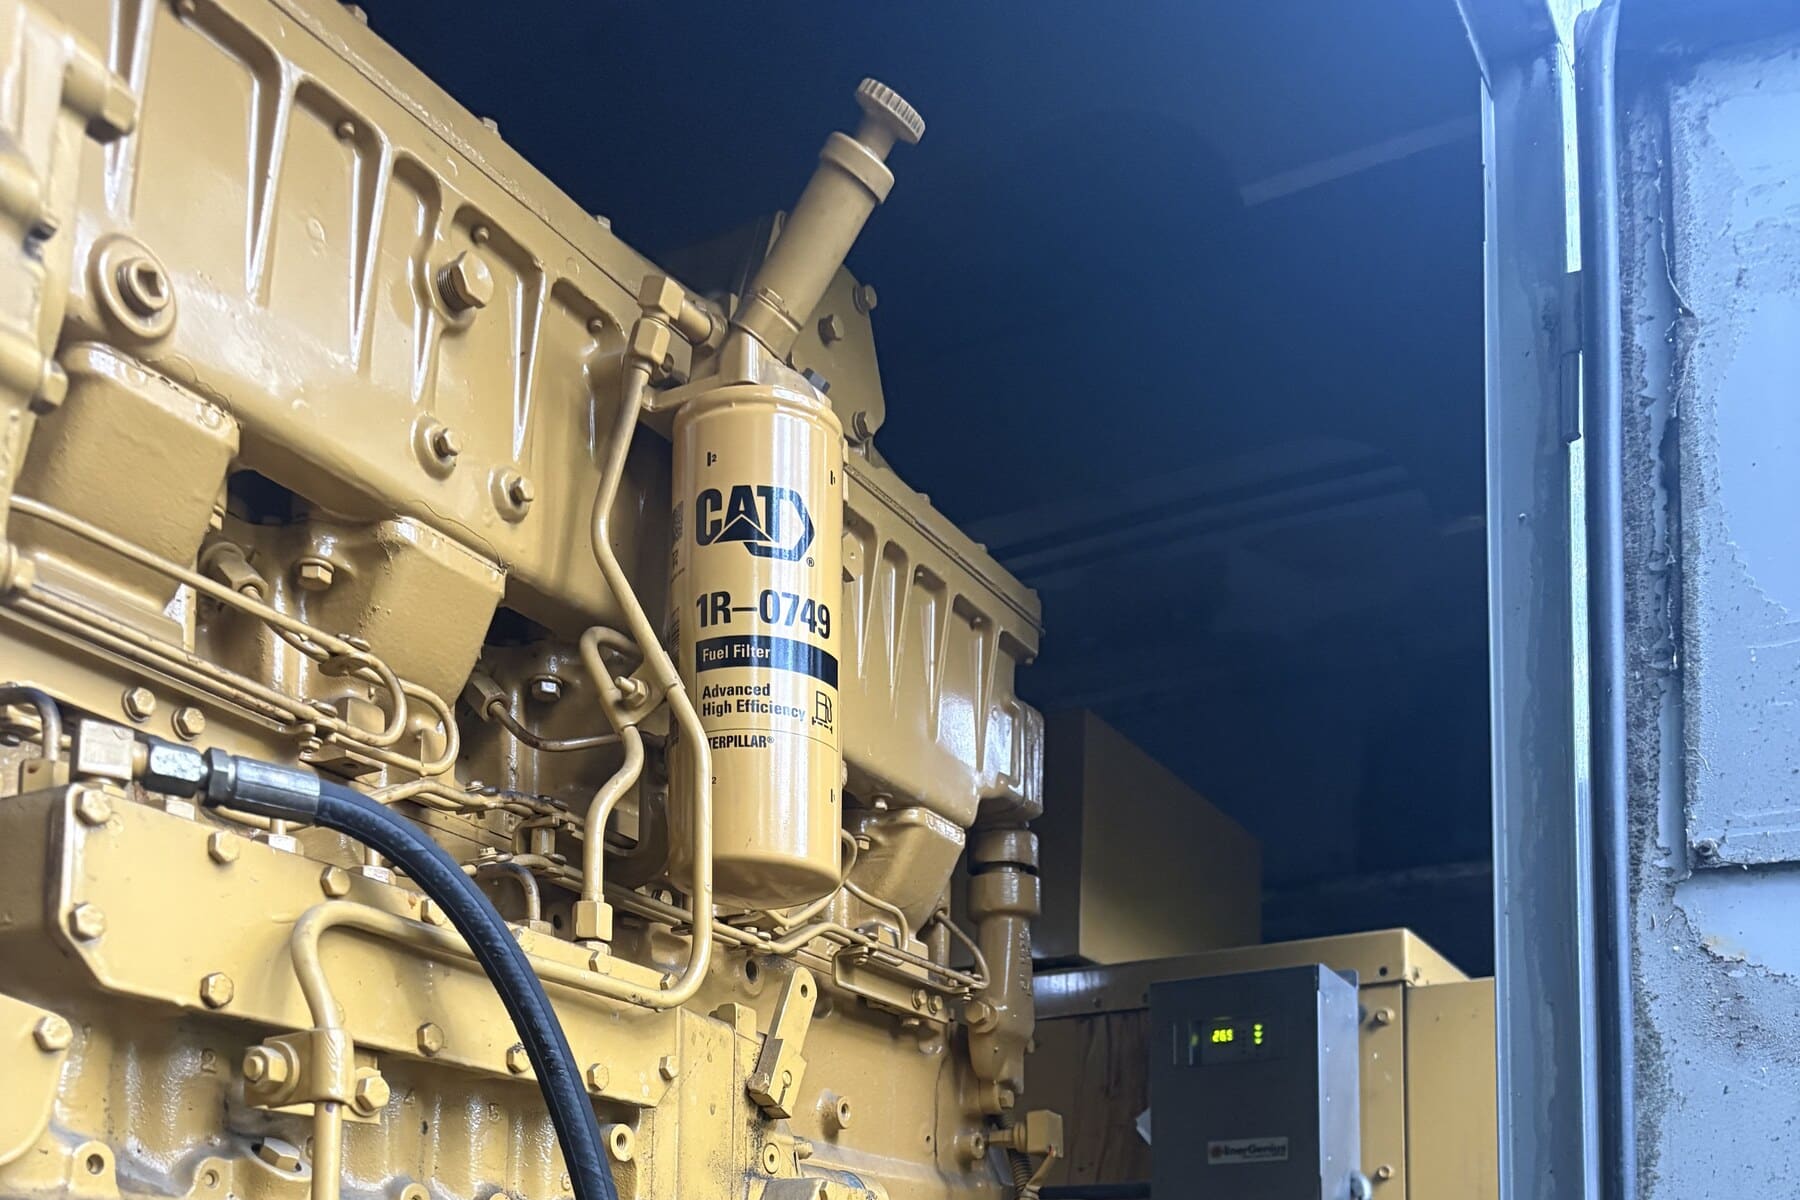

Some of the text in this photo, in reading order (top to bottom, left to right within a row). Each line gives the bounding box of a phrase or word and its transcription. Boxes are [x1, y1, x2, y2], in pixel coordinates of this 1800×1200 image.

[696, 485, 786, 547] CAT
[696, 589, 831, 640] 1R-0749
[702, 644, 771, 663] Fuel Filter
[702, 683, 771, 700] Advanced
[702, 699, 806, 722] High Efficiency
[708, 734, 767, 750] TERPILLAR
